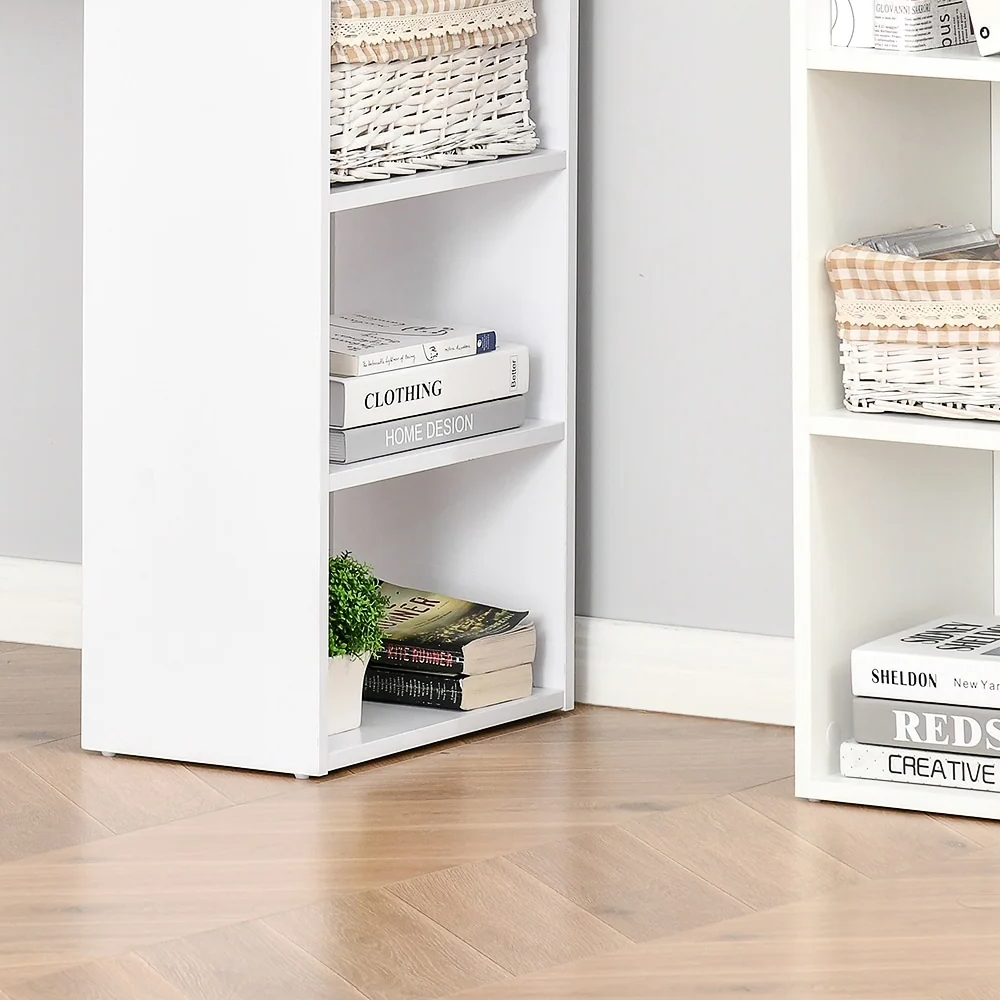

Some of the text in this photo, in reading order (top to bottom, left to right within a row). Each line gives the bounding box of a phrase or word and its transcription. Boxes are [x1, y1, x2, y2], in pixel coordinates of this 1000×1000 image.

[364, 380, 442, 410] CLOTHING
[385, 423, 423, 447] HOME
[378, 596, 440, 630] UNNER
[871, 668, 938, 689] SHELDON
[953, 678, 978, 689] New
[888, 754, 996, 785] CREATIVE
